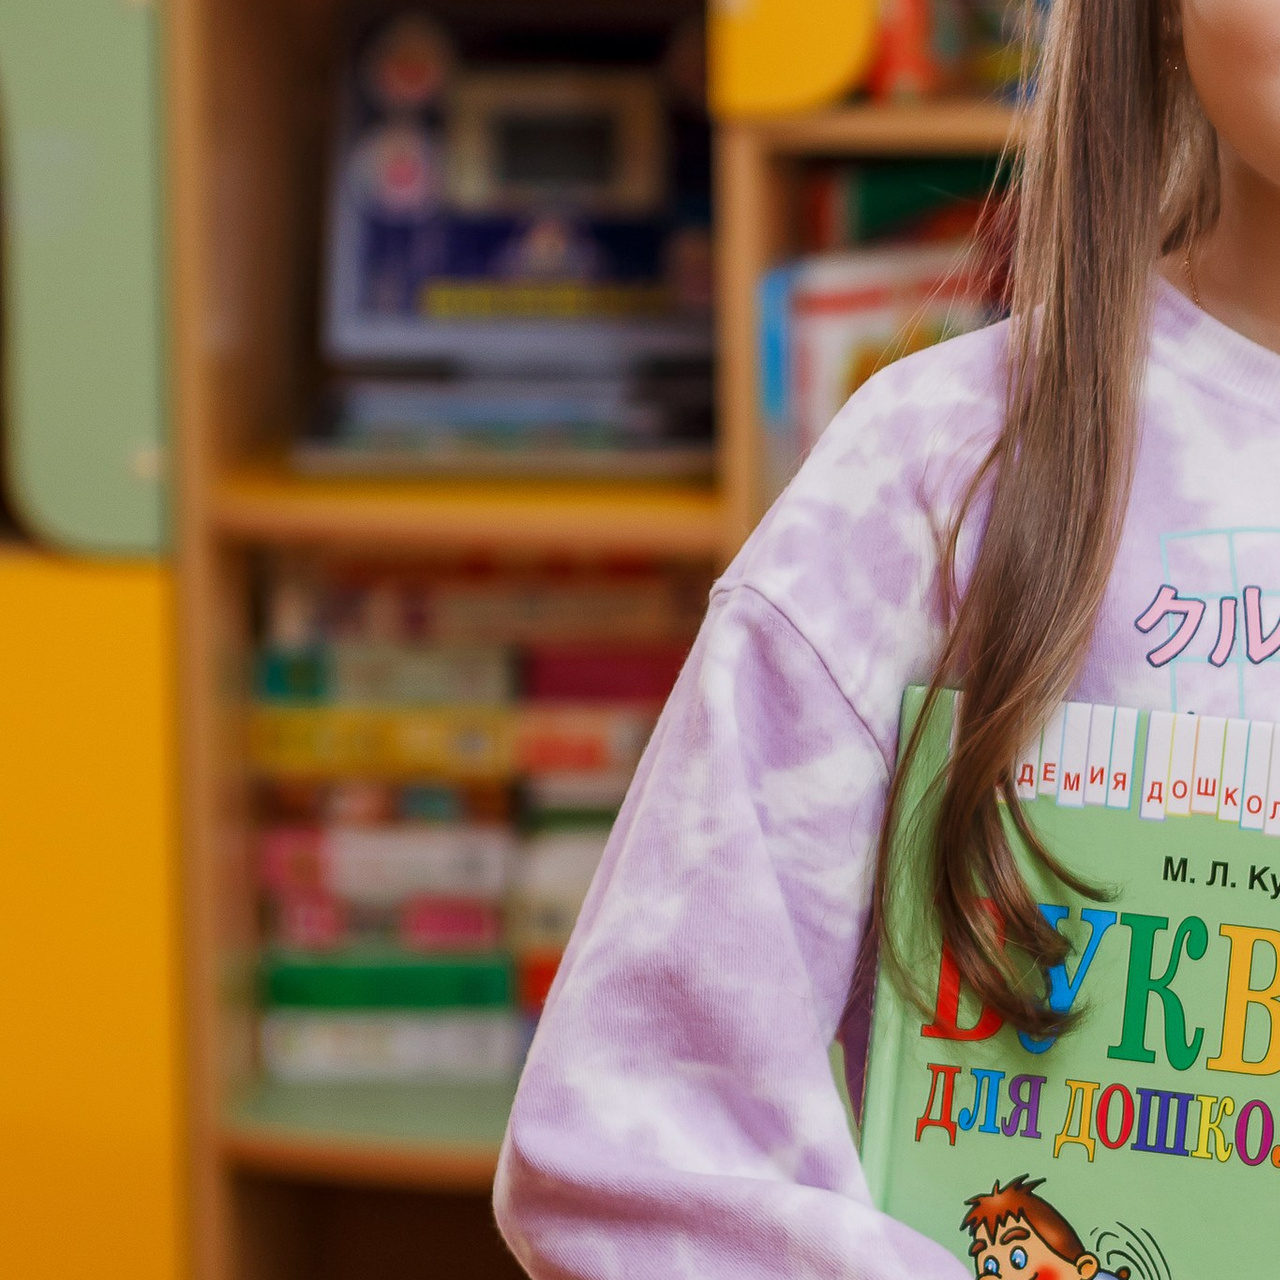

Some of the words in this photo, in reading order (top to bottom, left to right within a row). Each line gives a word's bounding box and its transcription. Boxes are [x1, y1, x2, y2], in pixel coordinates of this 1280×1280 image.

[1014, 759, 1128, 792] ДЕМИЯ
[1162, 855, 1196, 884] М.
[1205, 860, 1237, 888] Л.
[915, 1063, 1048, 1146] ДЛЯ
